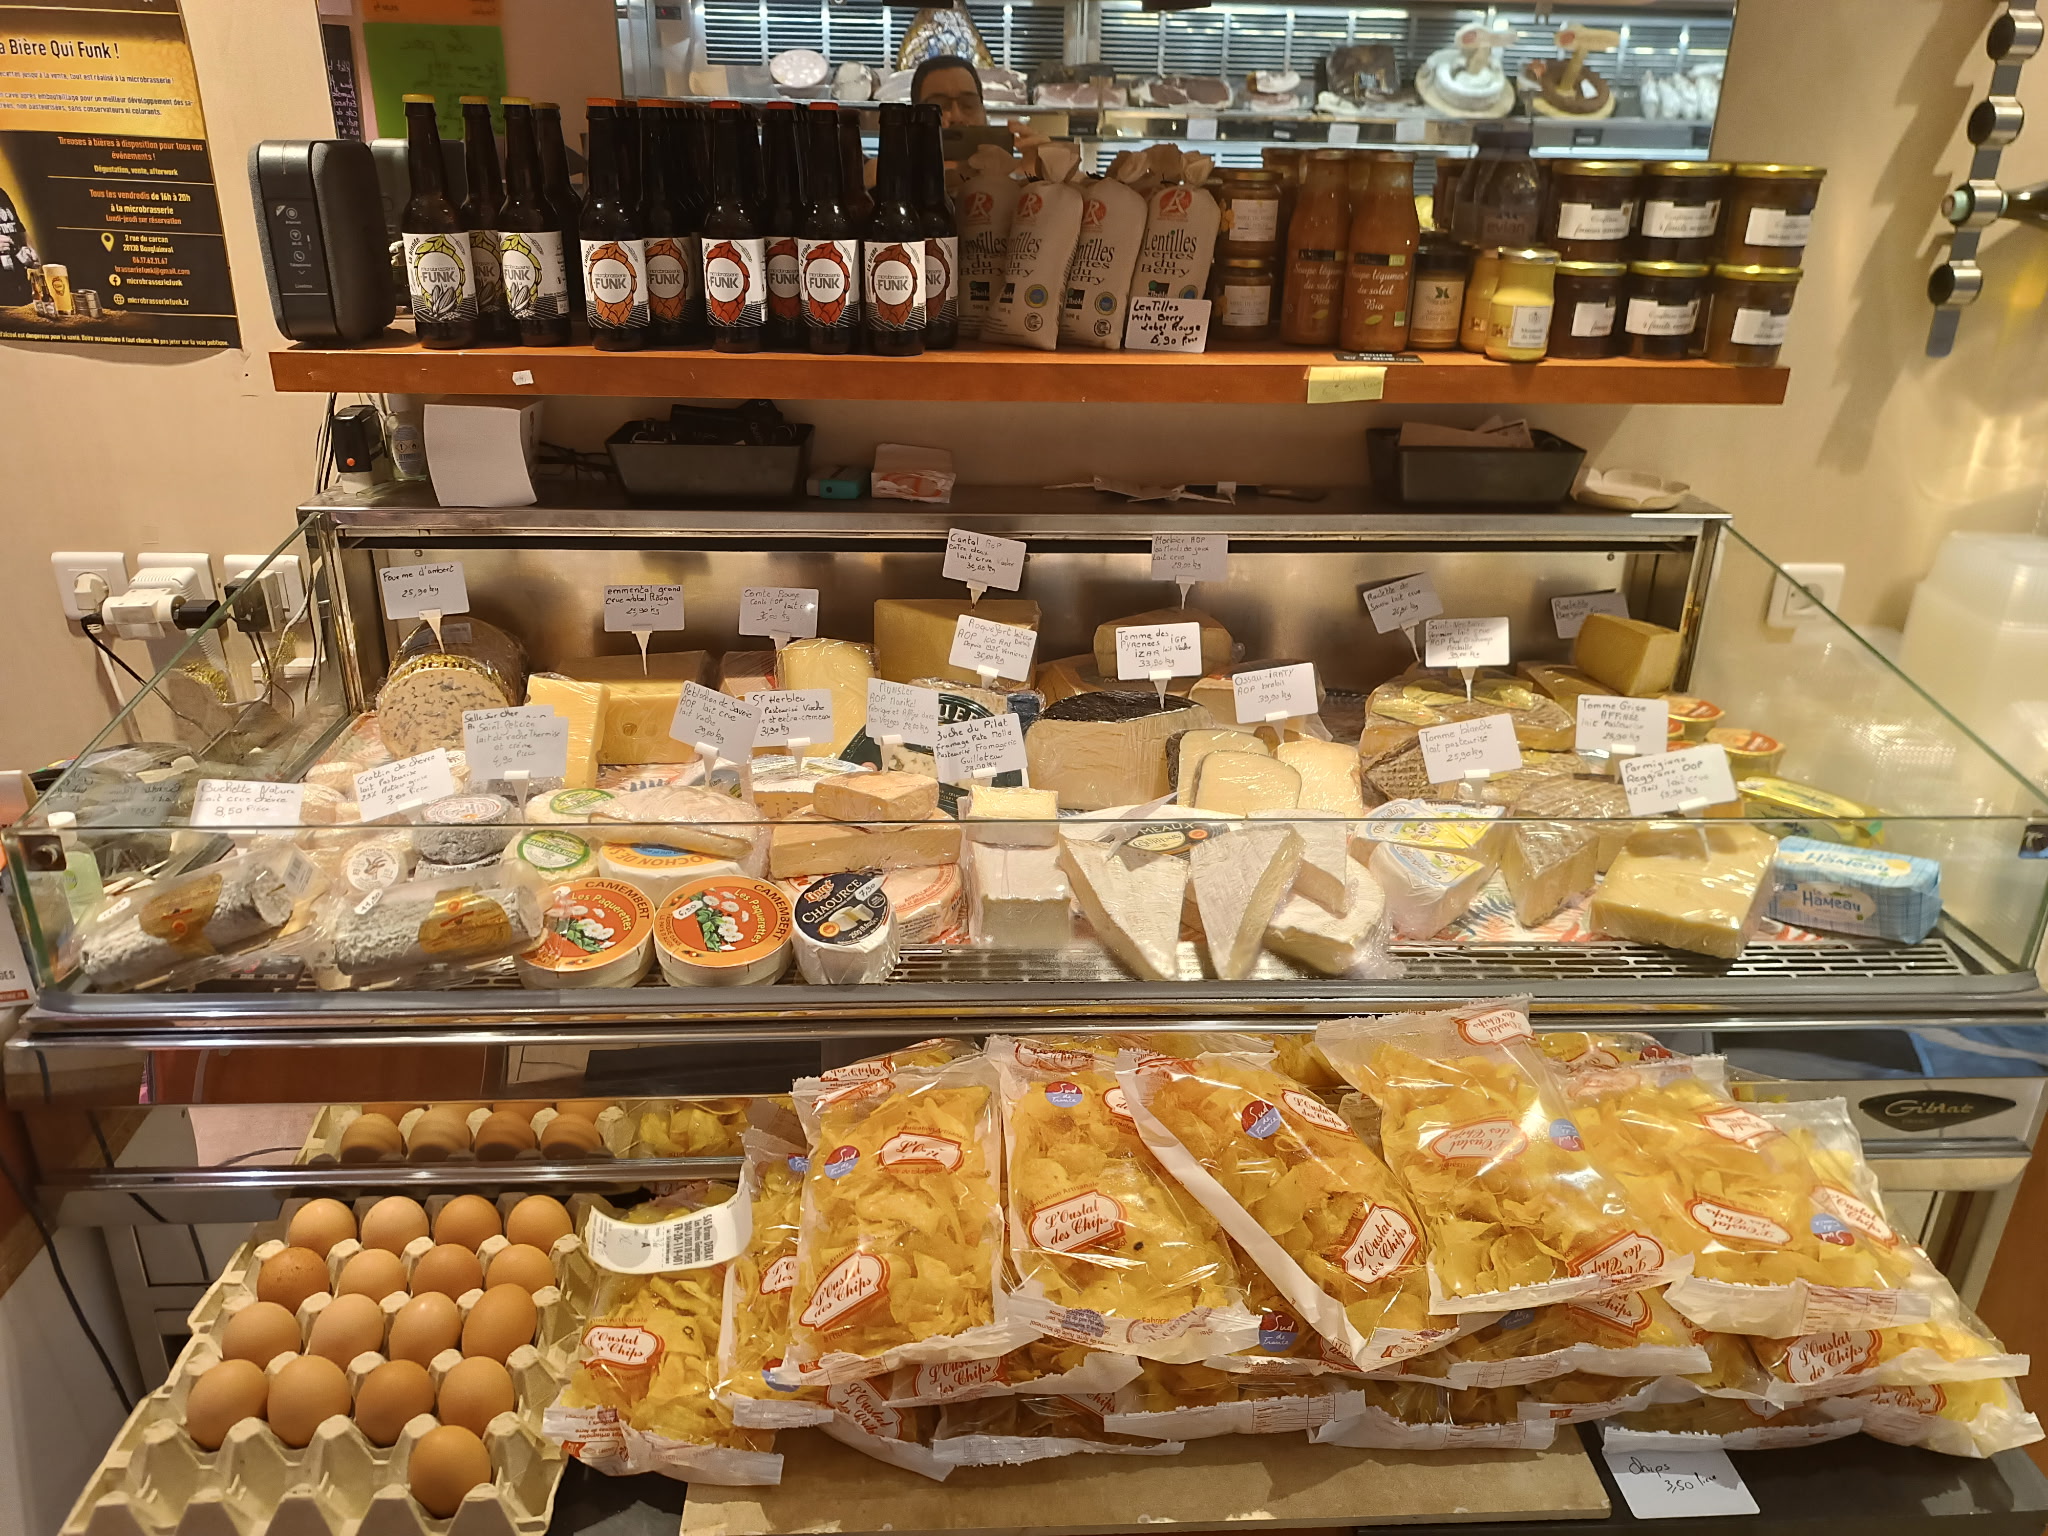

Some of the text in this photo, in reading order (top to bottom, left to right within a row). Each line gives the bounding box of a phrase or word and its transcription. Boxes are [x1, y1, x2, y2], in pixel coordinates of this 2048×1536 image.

[9, 38, 120, 59] Bière Qui Funk !
[126, 76, 172, 85] microbrasserie
[173, 98, 184, 106] des
[68, 105, 83, 113] sans
[83, 105, 125, 114] conservateurs
[131, 107, 162, 116] colorants.
[121, 139, 159, 151] disposition
[158, 142, 174, 151] pour
[191, 143, 203, 151] vos
[149, 166, 179, 176] afterwork
[88, 188, 191, 203] Tous les vendredis de 16h 20h
[115, 204, 124, 214] la
[123, 204, 175, 215] microbrasserie
[148, 215, 182, 226] réservation
[129, 235, 140, 243] rue
[140, 235, 148, 243] du
[148, 235, 170, 244] carcan
[1144, 229, 1198, 255] Lentilles
[1143, 250, 1195, 261] vertes
[1140, 263, 1191, 278] Berry
[1154, 259, 1177, 269] du
[421, 271, 456, 283] FUNK
[595, 277, 627, 290] FUNK
[650, 272, 681, 285] FUNK
[709, 276, 739, 289] FUNK
[809, 277, 840, 290] FUNK
[877, 279, 909, 292] FUNK
[1368, 284, 1395, 296] soleil
[1364, 298, 1385, 312] Bio
[1157, 313, 1185, 323] Berry
[1171, 321, 1201, 336] Rouge
[950, 532, 980, 547] Cantal
[1154, 535, 1206, 545] Morbier AOP
[657, 585, 681, 597] grand
[957, 629, 978, 642] AOP
[1117, 628, 1170, 642] Tomme des
[869, 692, 887, 704] AOP
[1237, 685, 1257, 697] AOP
[679, 695, 697, 709] AOP
[702, 701, 717, 716] lait
[683, 682, 754, 720] Reblochon de Savoie
[1580, 697, 1648, 713] Tomme Grise
[678, 707, 693, 718] lait
[966, 718, 1009, 734] du Pilat
[1420, 719, 1493, 743] Tomme blanche
[1425, 743, 1441, 755] lait
[1624, 756, 1687, 775] Parmigiano
[357, 769, 391, 786] Crottin
[393, 762, 407, 773] de
[359, 783, 375, 795] lait
[213, 805, 243, 818] 8,50
[1139, 822, 1195, 836] MEAUX
[527, 837, 582, 860] SAINT-FÉLICIEN
[584, 880, 651, 921] CAMEMBERT
[801, 877, 863, 925] CHAOURCE
[753, 883, 792, 943] CAMEMBERT
[1250, 1103, 1269, 1124] Sud
[837, 1148, 857, 1165] Sud
[1044, 1199, 1100, 1229] L'Oustal
[1050, 1214, 1109, 1245] des Chips
[1353, 1213, 1393, 1272] L'Oustal
[1380, 1227, 1408, 1260] Chips
[1270, 1314, 1295, 1332] Sud
[1798, 1330, 1852, 1361] L'Oustal
[1826, 1342, 1864, 1368] Chips
[1628, 1456, 1671, 1478] Chips
[1664, 1479, 1694, 1494] 3,50
